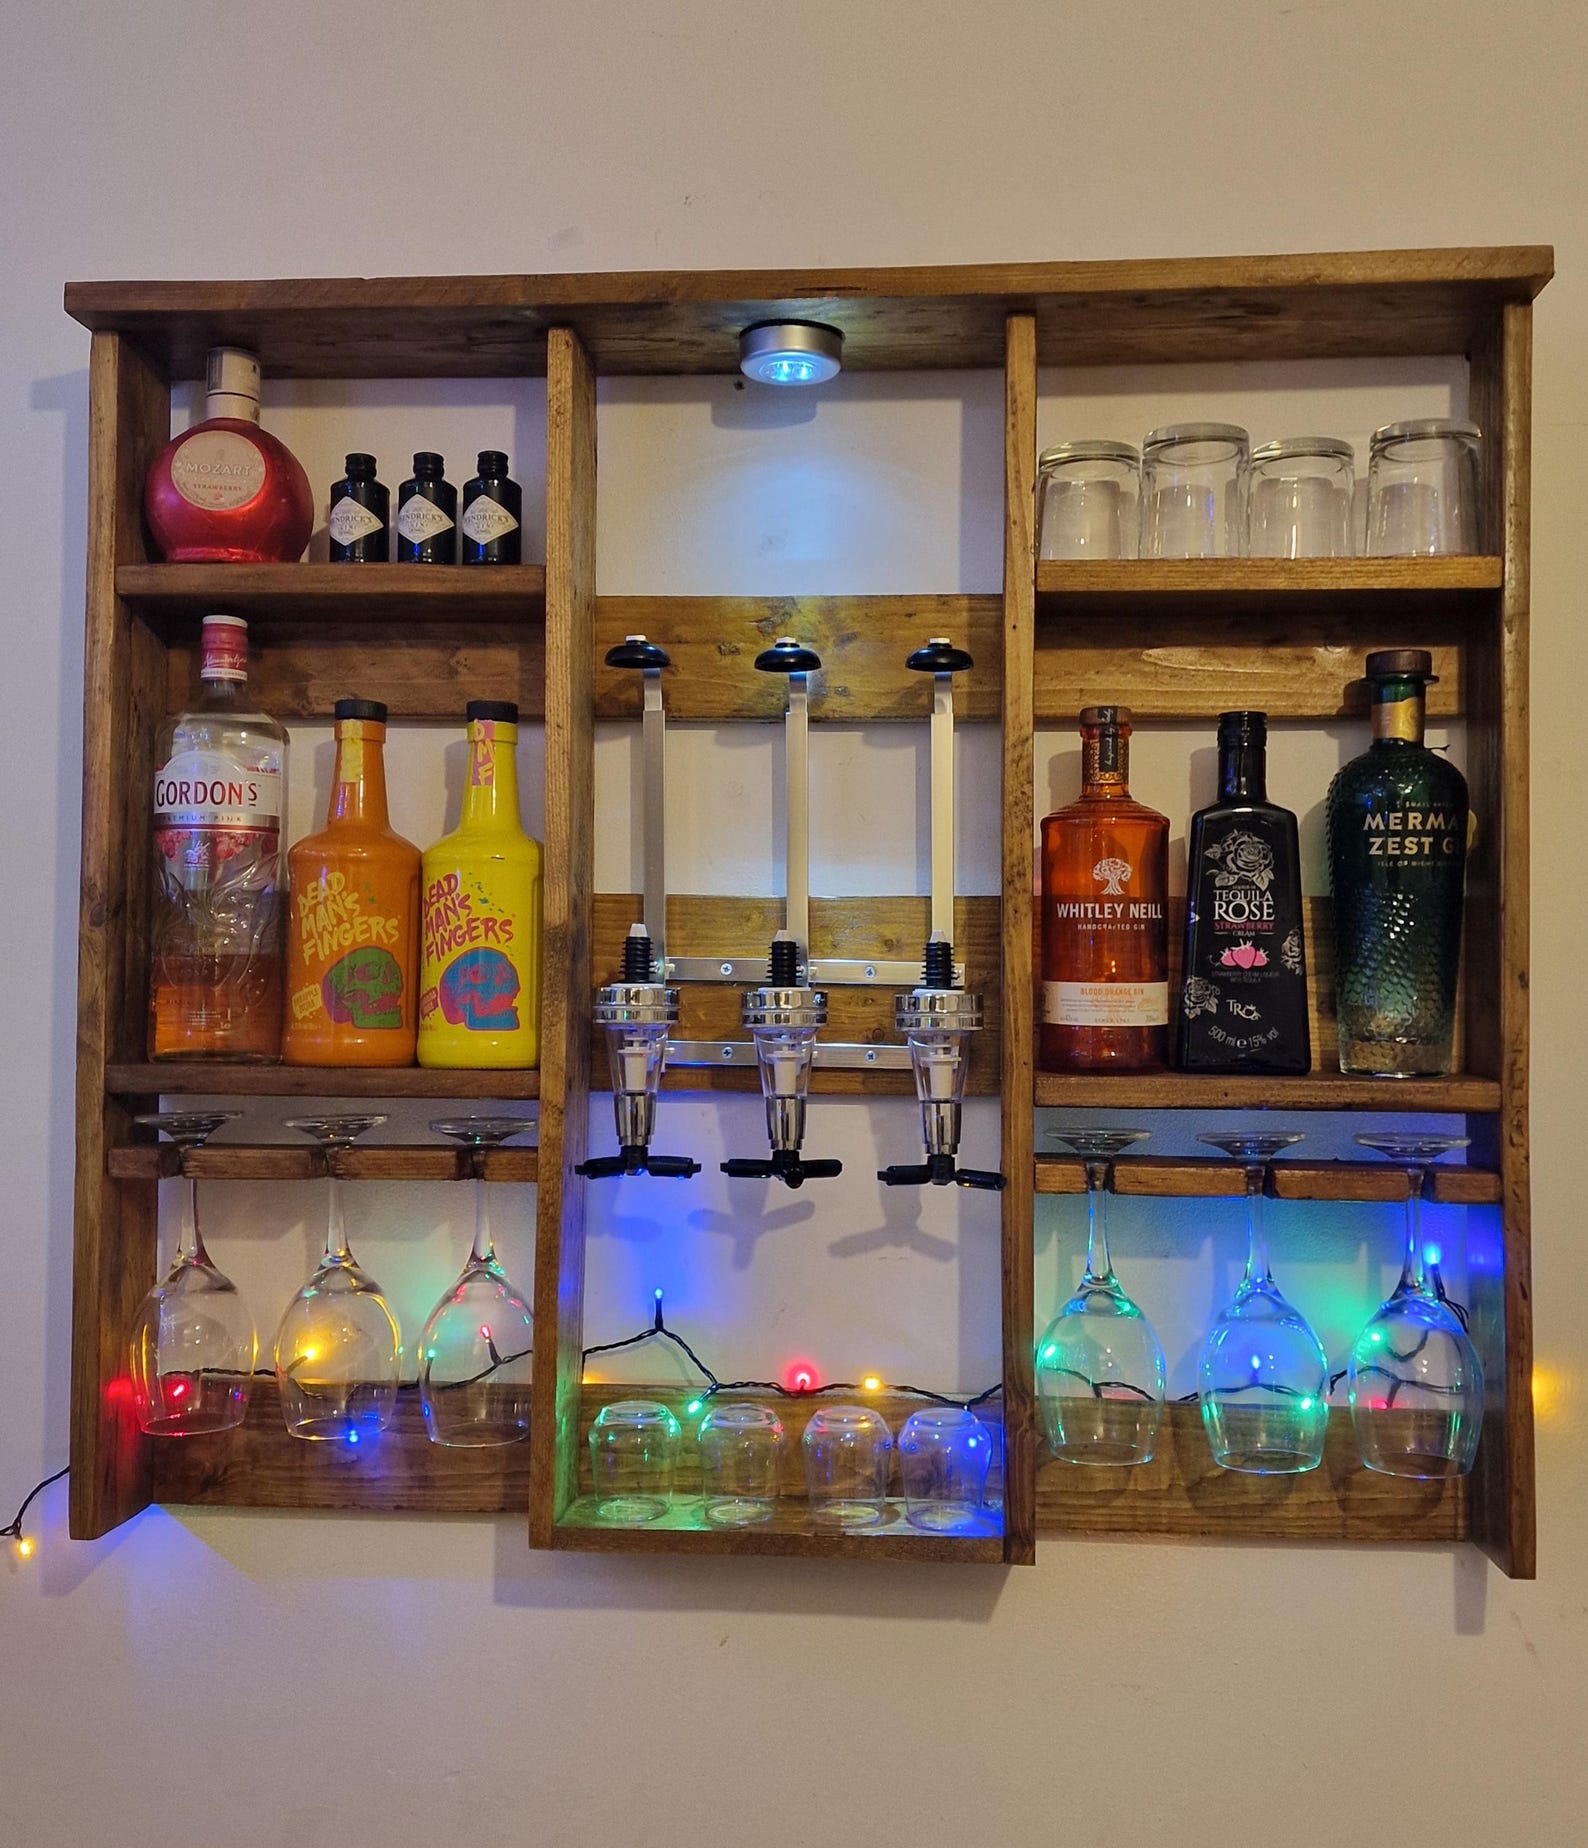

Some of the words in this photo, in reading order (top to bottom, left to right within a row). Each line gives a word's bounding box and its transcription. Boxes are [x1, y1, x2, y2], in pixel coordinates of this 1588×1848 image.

[186, 463, 252, 475] MOZART
[156, 779, 258, 808] GORDON'S
[1368, 836, 1434, 855] ZEST
[297, 871, 345, 918] DEAD
[424, 873, 460, 920] DEAD
[1213, 889, 1273, 902] TEQUILA
[301, 891, 361, 940] MAN'S
[1056, 902, 1125, 919] WHITLEY
[1129, 902, 1163, 919] NEILL
[1213, 901, 1275, 923] ROSE
[1214, 921, 1274, 930] STRAWBERRY
[303, 915, 400, 966] FINGERS
[426, 917, 514, 968] FINGERS
[1080, 986, 1102, 996] BLOOD
[1208, 1025, 1227, 1042] 500
